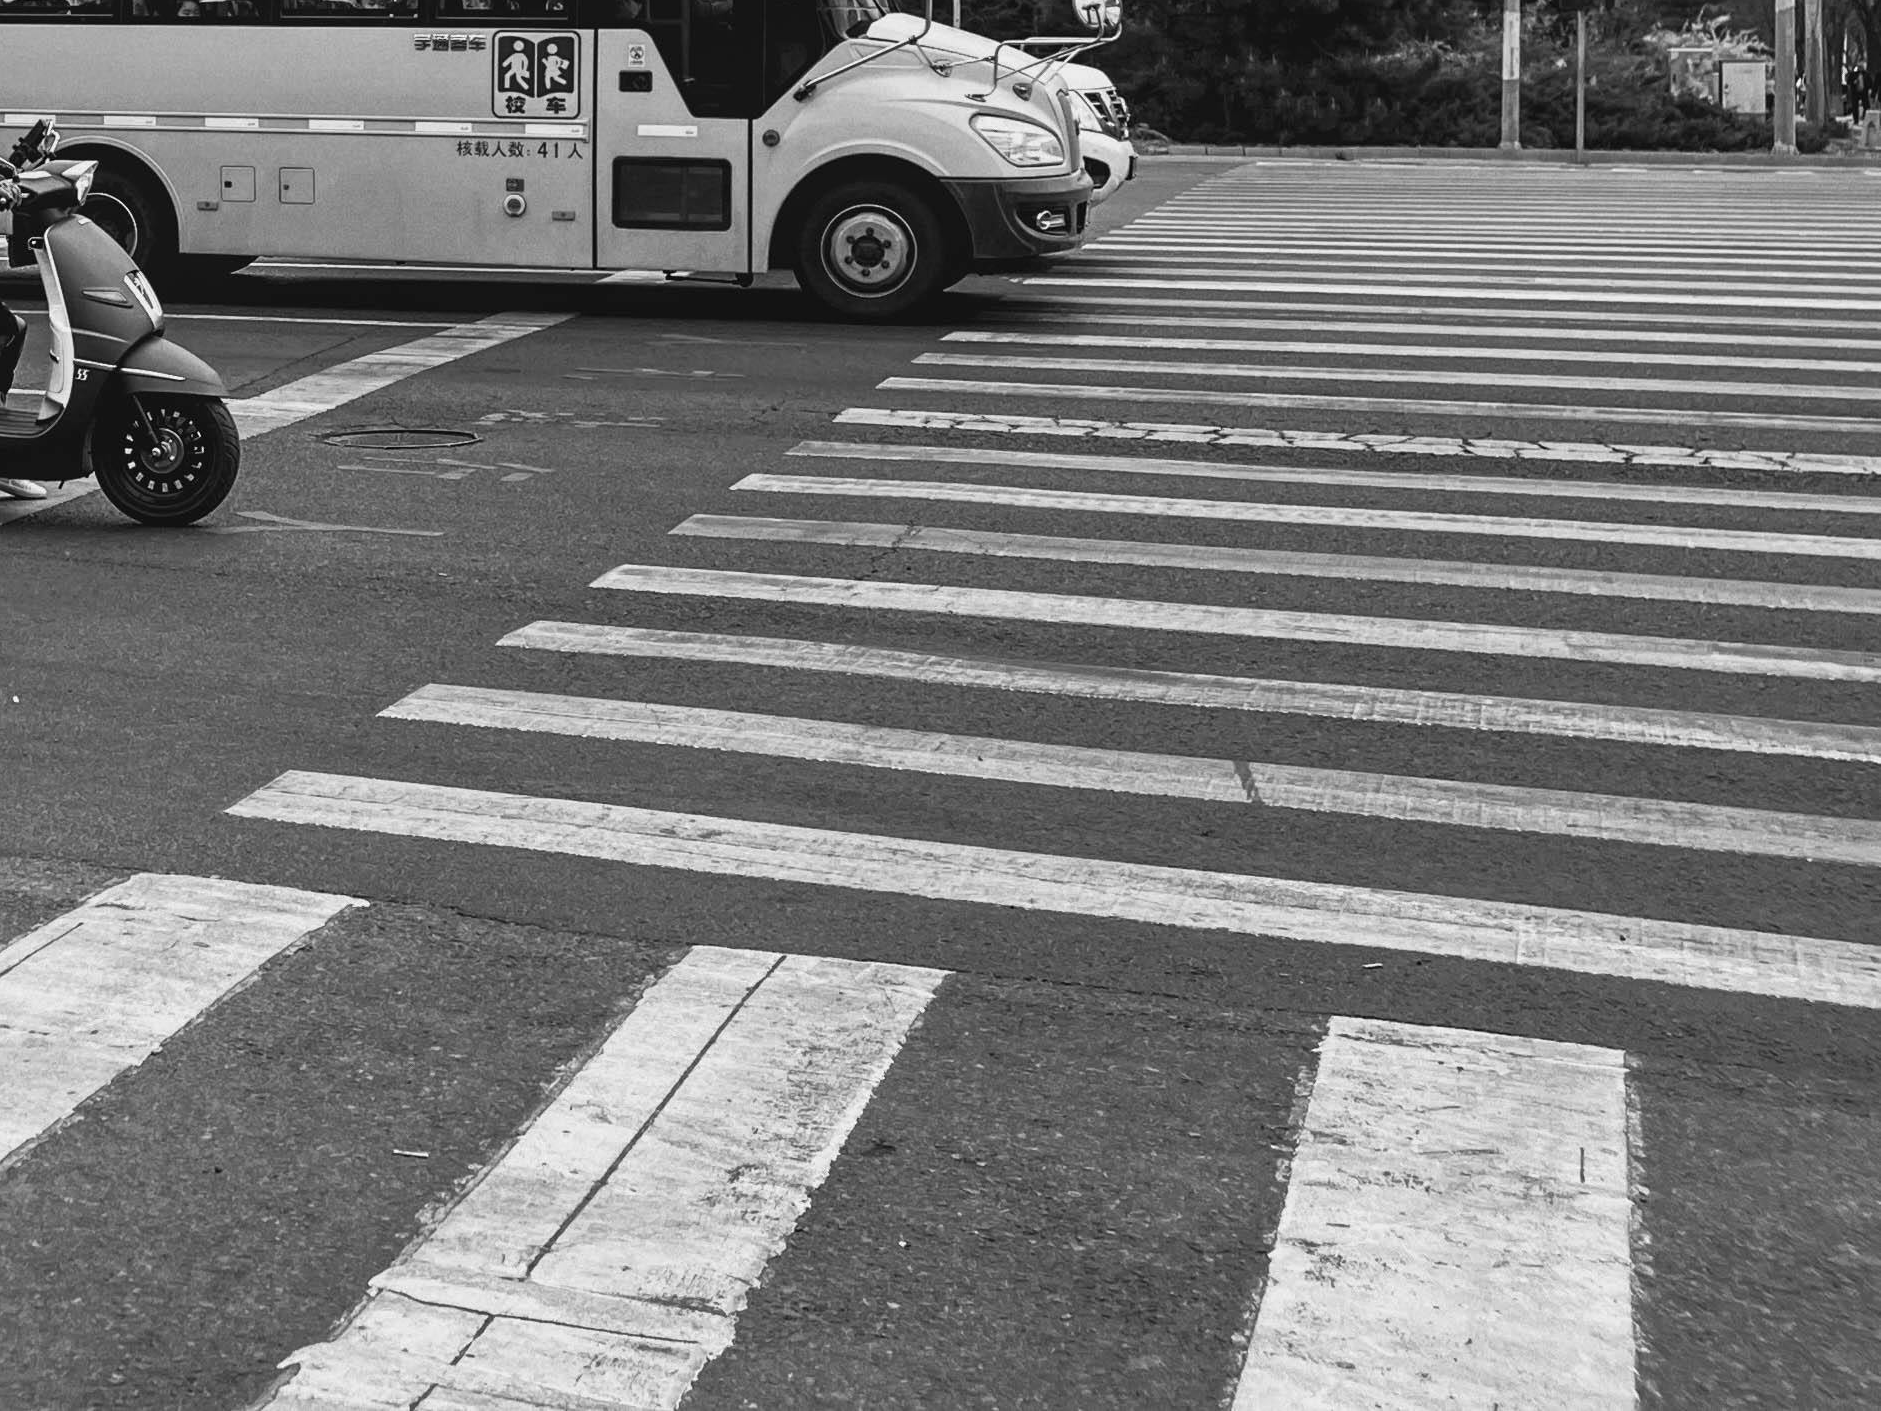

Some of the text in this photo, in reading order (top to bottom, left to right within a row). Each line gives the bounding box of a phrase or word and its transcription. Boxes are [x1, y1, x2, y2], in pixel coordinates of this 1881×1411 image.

[414, 34, 486, 52] 宇通客车
[505, 95, 567, 114] 校车
[537, 142, 559, 158] 41
[568, 142, 583, 159] 人
